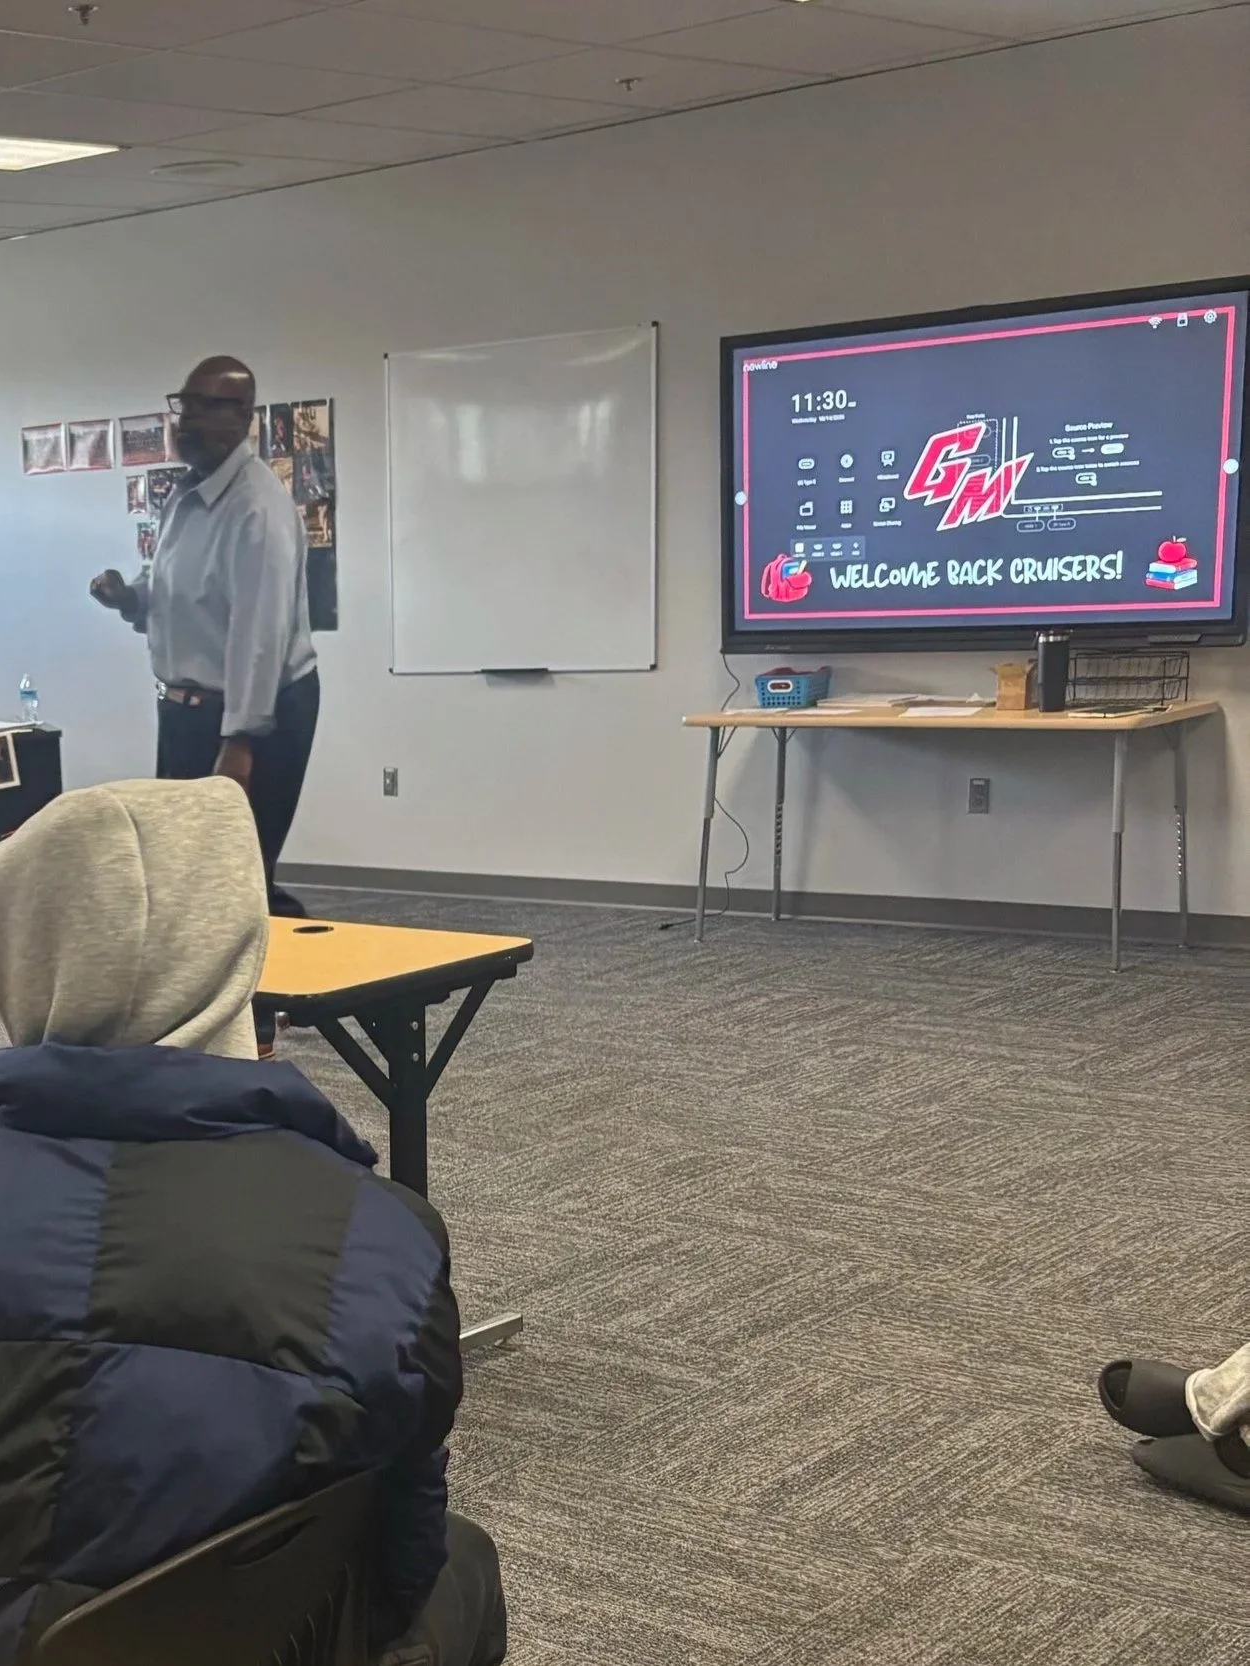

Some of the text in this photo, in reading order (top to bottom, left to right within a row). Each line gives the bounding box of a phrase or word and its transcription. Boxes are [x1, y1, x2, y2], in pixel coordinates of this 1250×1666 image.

[791, 390, 848, 413] 11:30
[947, 558, 1003, 586] BACK
[1009, 550, 1124, 584] CRUISERS!
